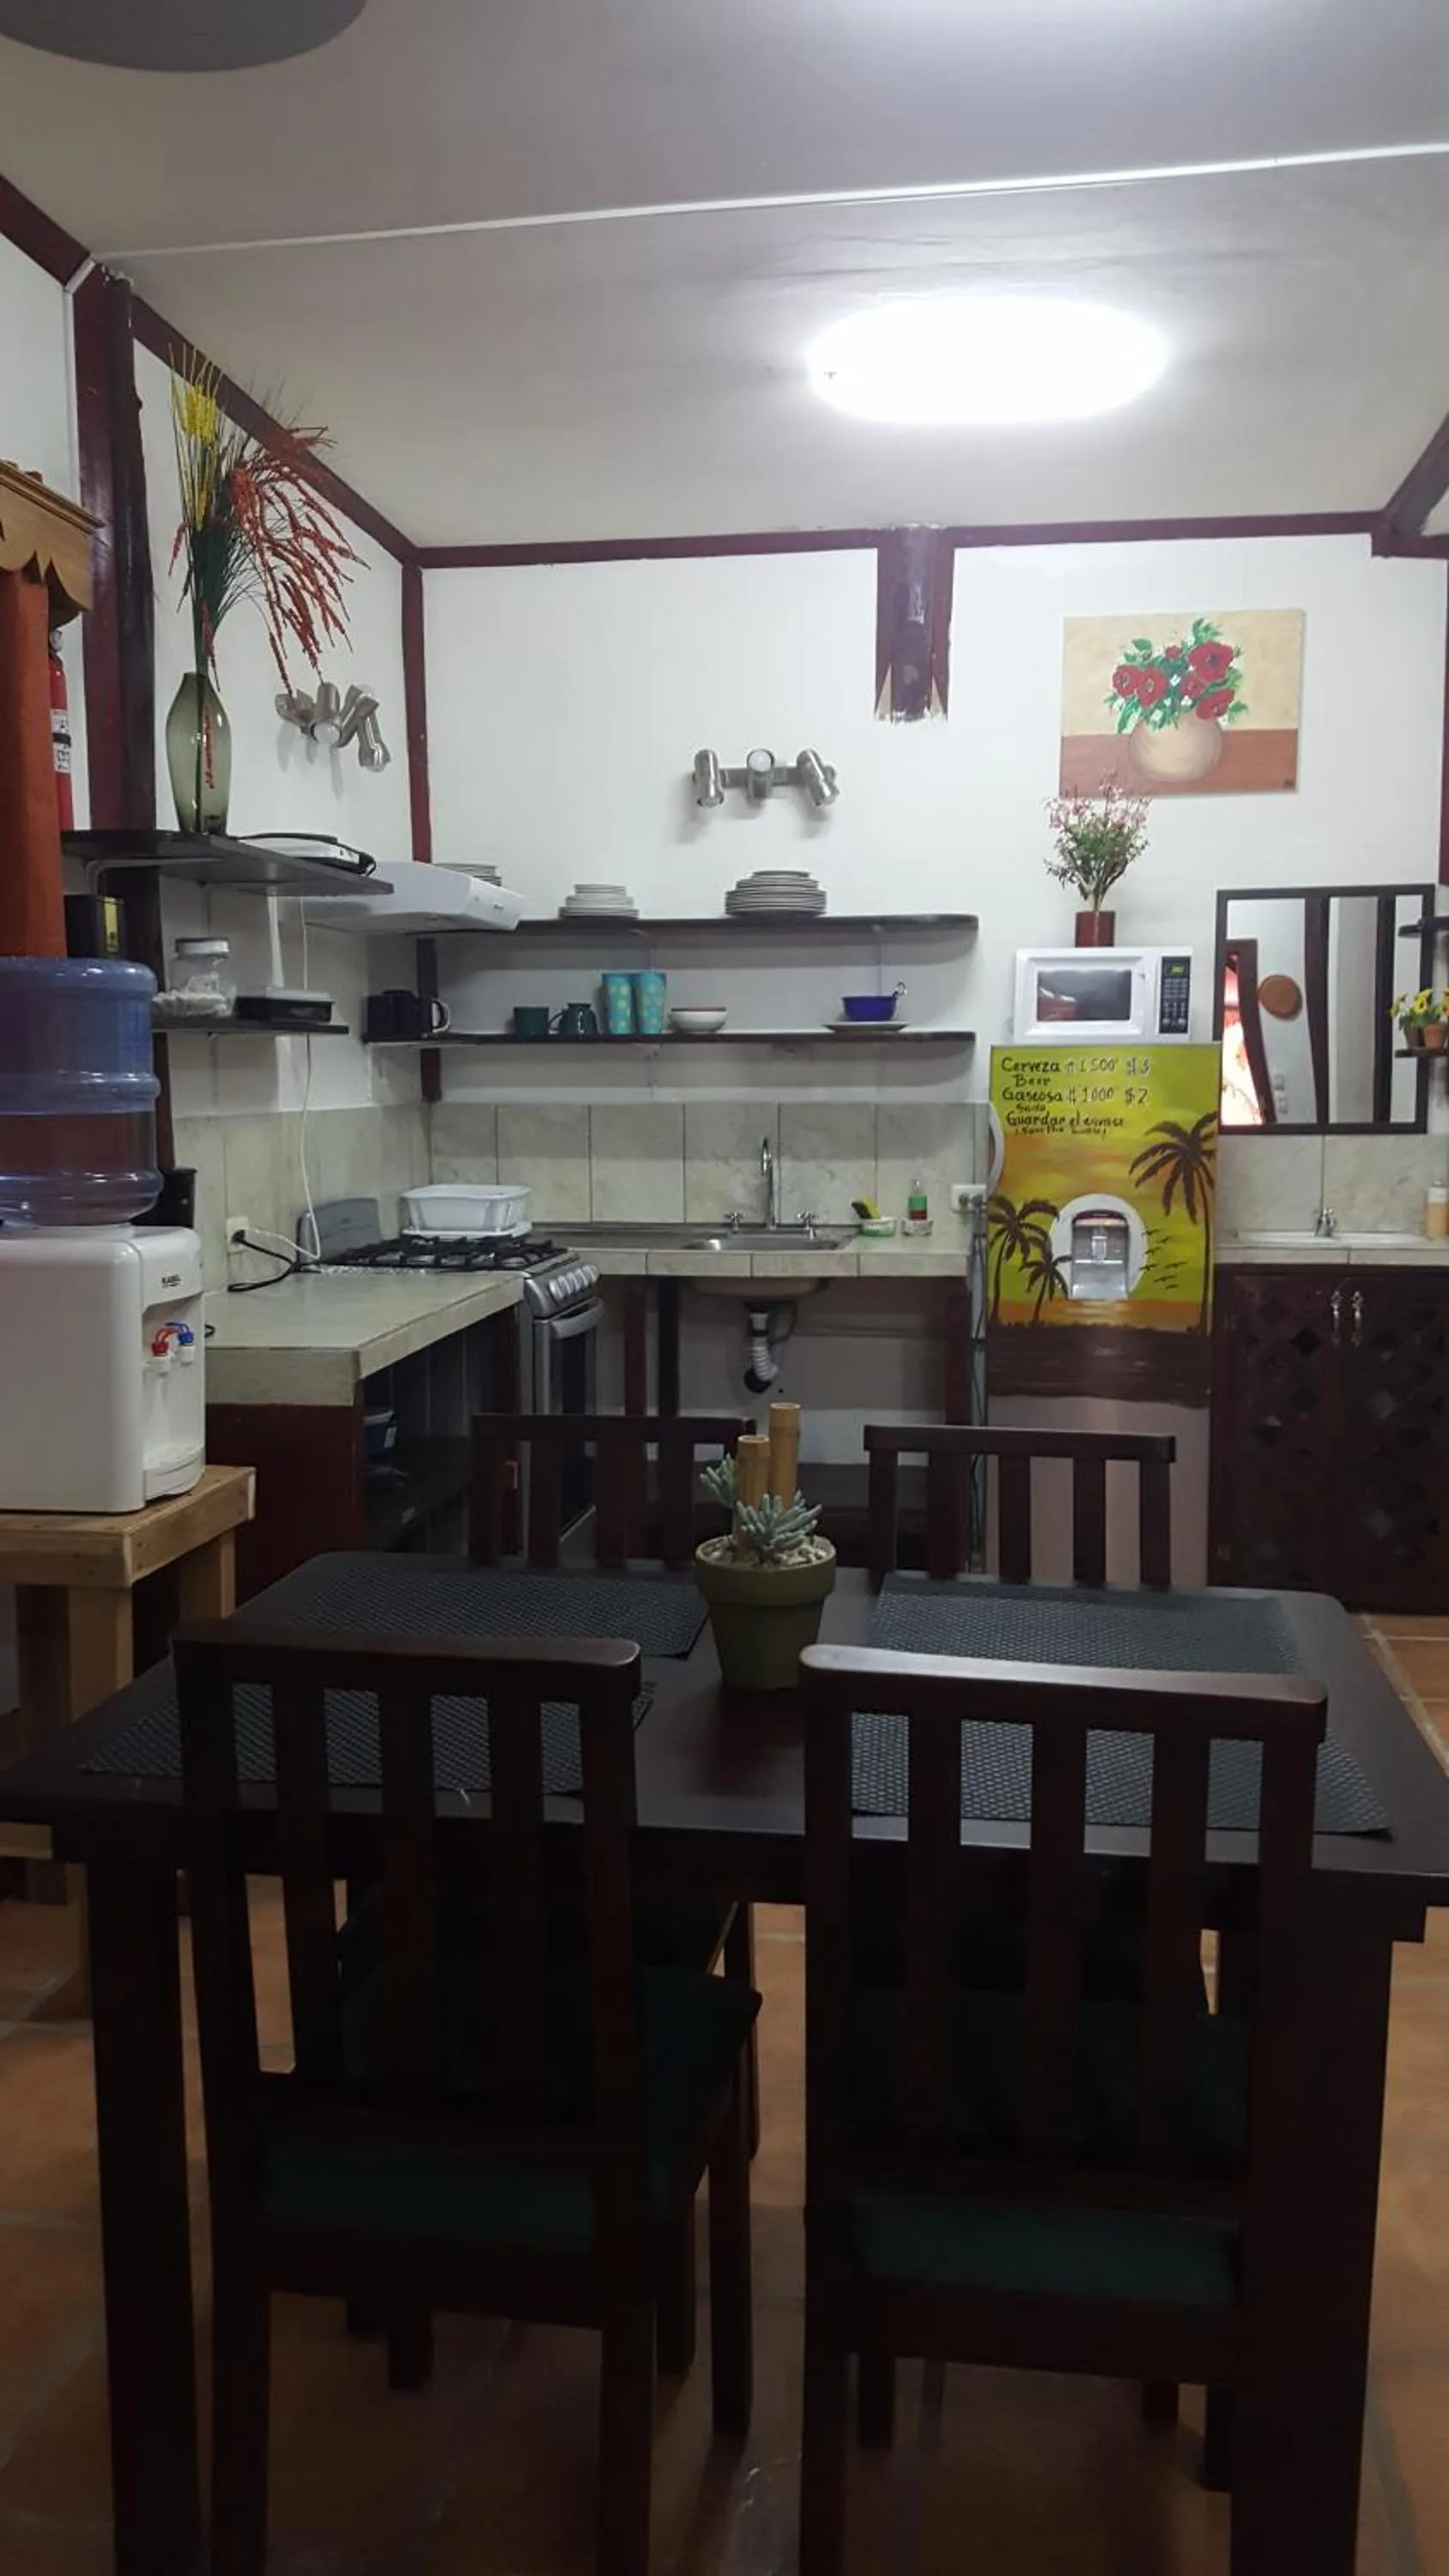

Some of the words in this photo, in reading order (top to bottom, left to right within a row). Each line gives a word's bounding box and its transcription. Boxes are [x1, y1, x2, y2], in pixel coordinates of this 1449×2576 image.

[1002, 1057, 1060, 1072] Cerveza
[1011, 1073, 1051, 1087] Beer
[1002, 1086, 1063, 1103] Gaseosa
[1006, 1110, 1065, 1126] Guardar
